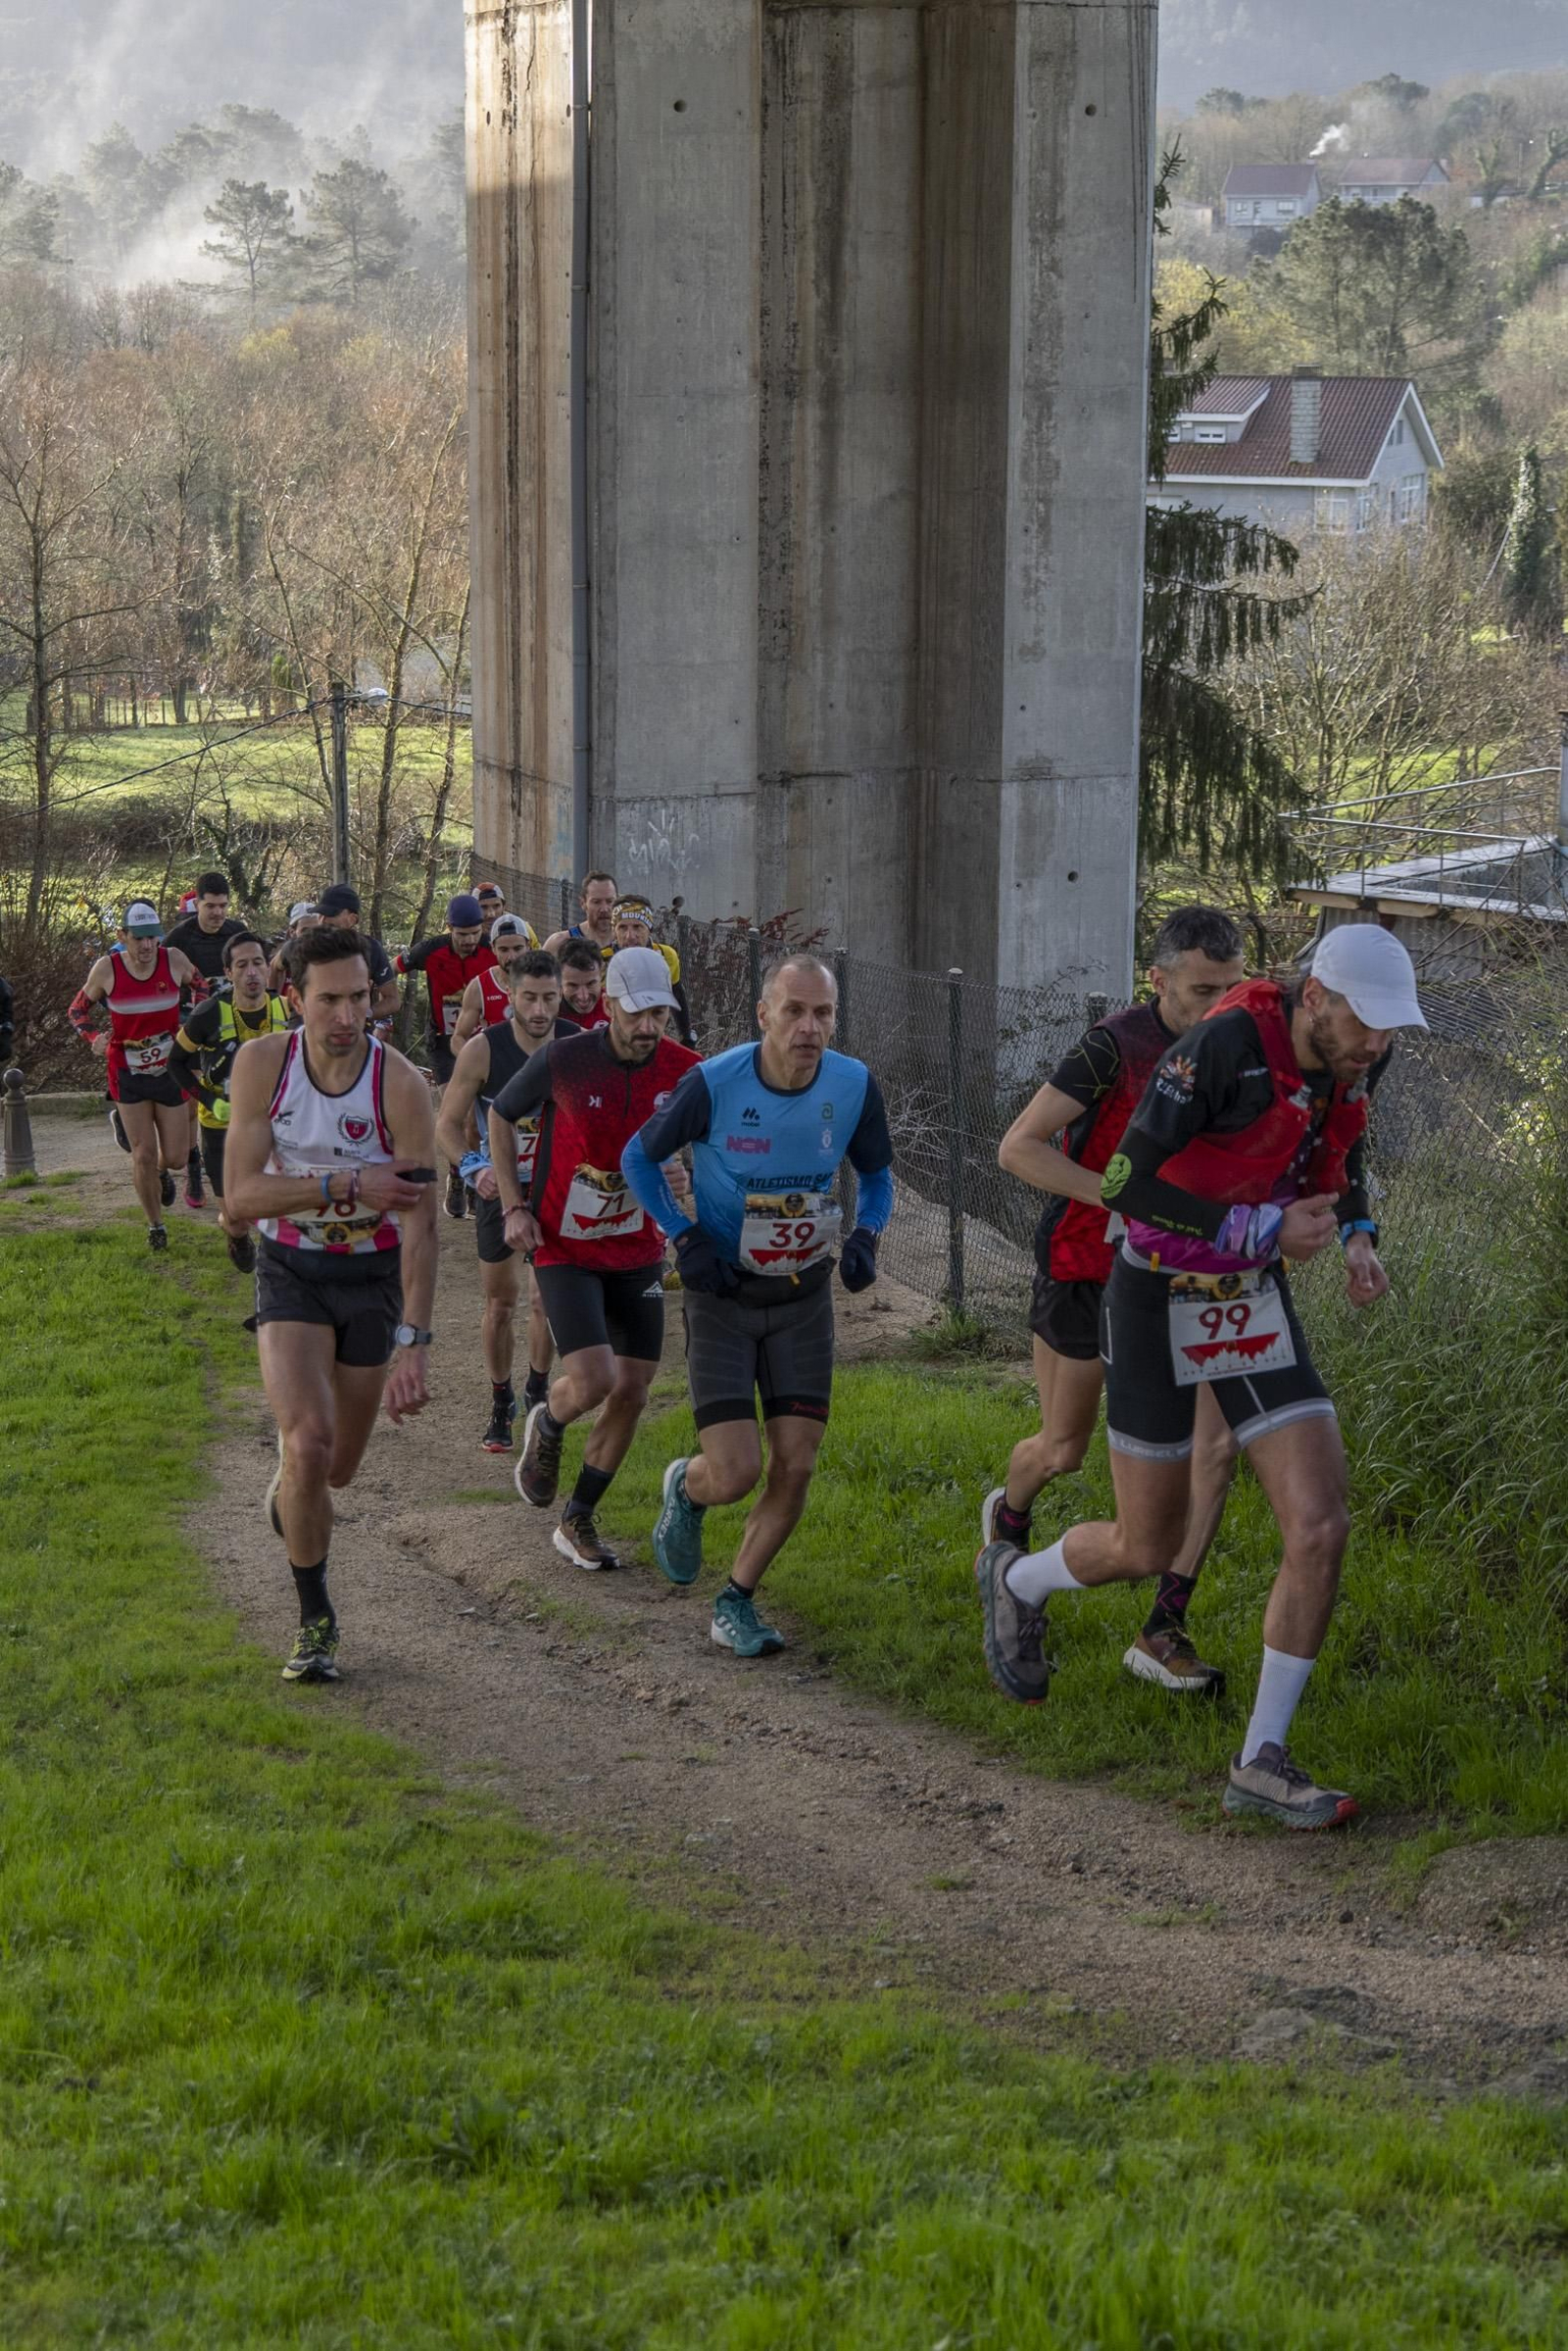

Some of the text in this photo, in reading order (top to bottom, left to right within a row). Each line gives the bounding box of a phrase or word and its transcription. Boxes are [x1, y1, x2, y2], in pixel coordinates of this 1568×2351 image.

[140, 1047, 161, 1063] 59
[747, 1176, 812, 1189] ATLETISMO
[597, 1193, 625, 1217] 71
[768, 1221, 815, 1249] 39
[1199, 1302, 1251, 1340] 99
